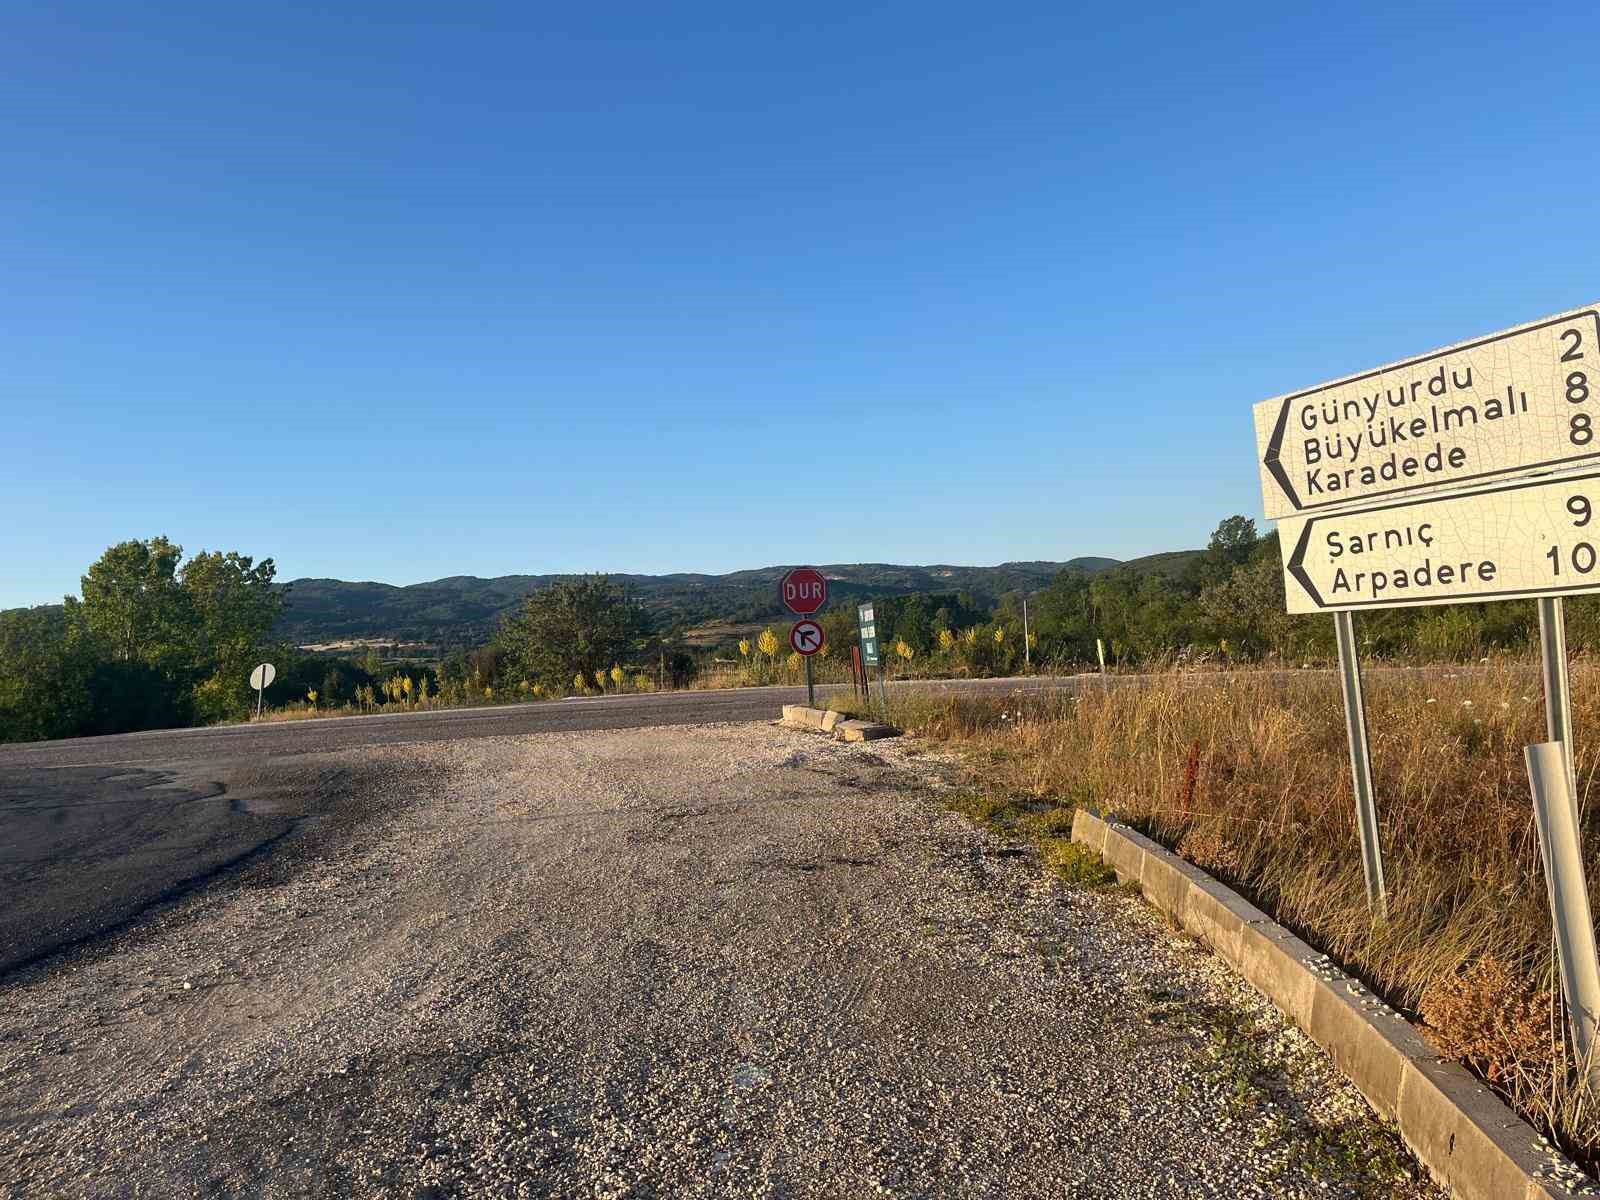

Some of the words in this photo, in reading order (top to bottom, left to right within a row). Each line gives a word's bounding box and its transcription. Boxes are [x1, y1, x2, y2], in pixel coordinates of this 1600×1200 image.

[1301, 366, 1473, 430] Günyurdu
[1559, 328, 1584, 363] 2
[1304, 385, 1528, 465] Büyükelmalı
[1565, 371, 1590, 404] 8
[1306, 443, 1466, 496] Karadede
[1569, 413, 1593, 446] 8
[1326, 523, 1434, 564] Şarnıç
[1566, 495, 1592, 527] 9
[786, 582, 823, 600] DUR
[1332, 558, 1497, 598] Arpadere
[1546, 542, 1597, 576] 10
